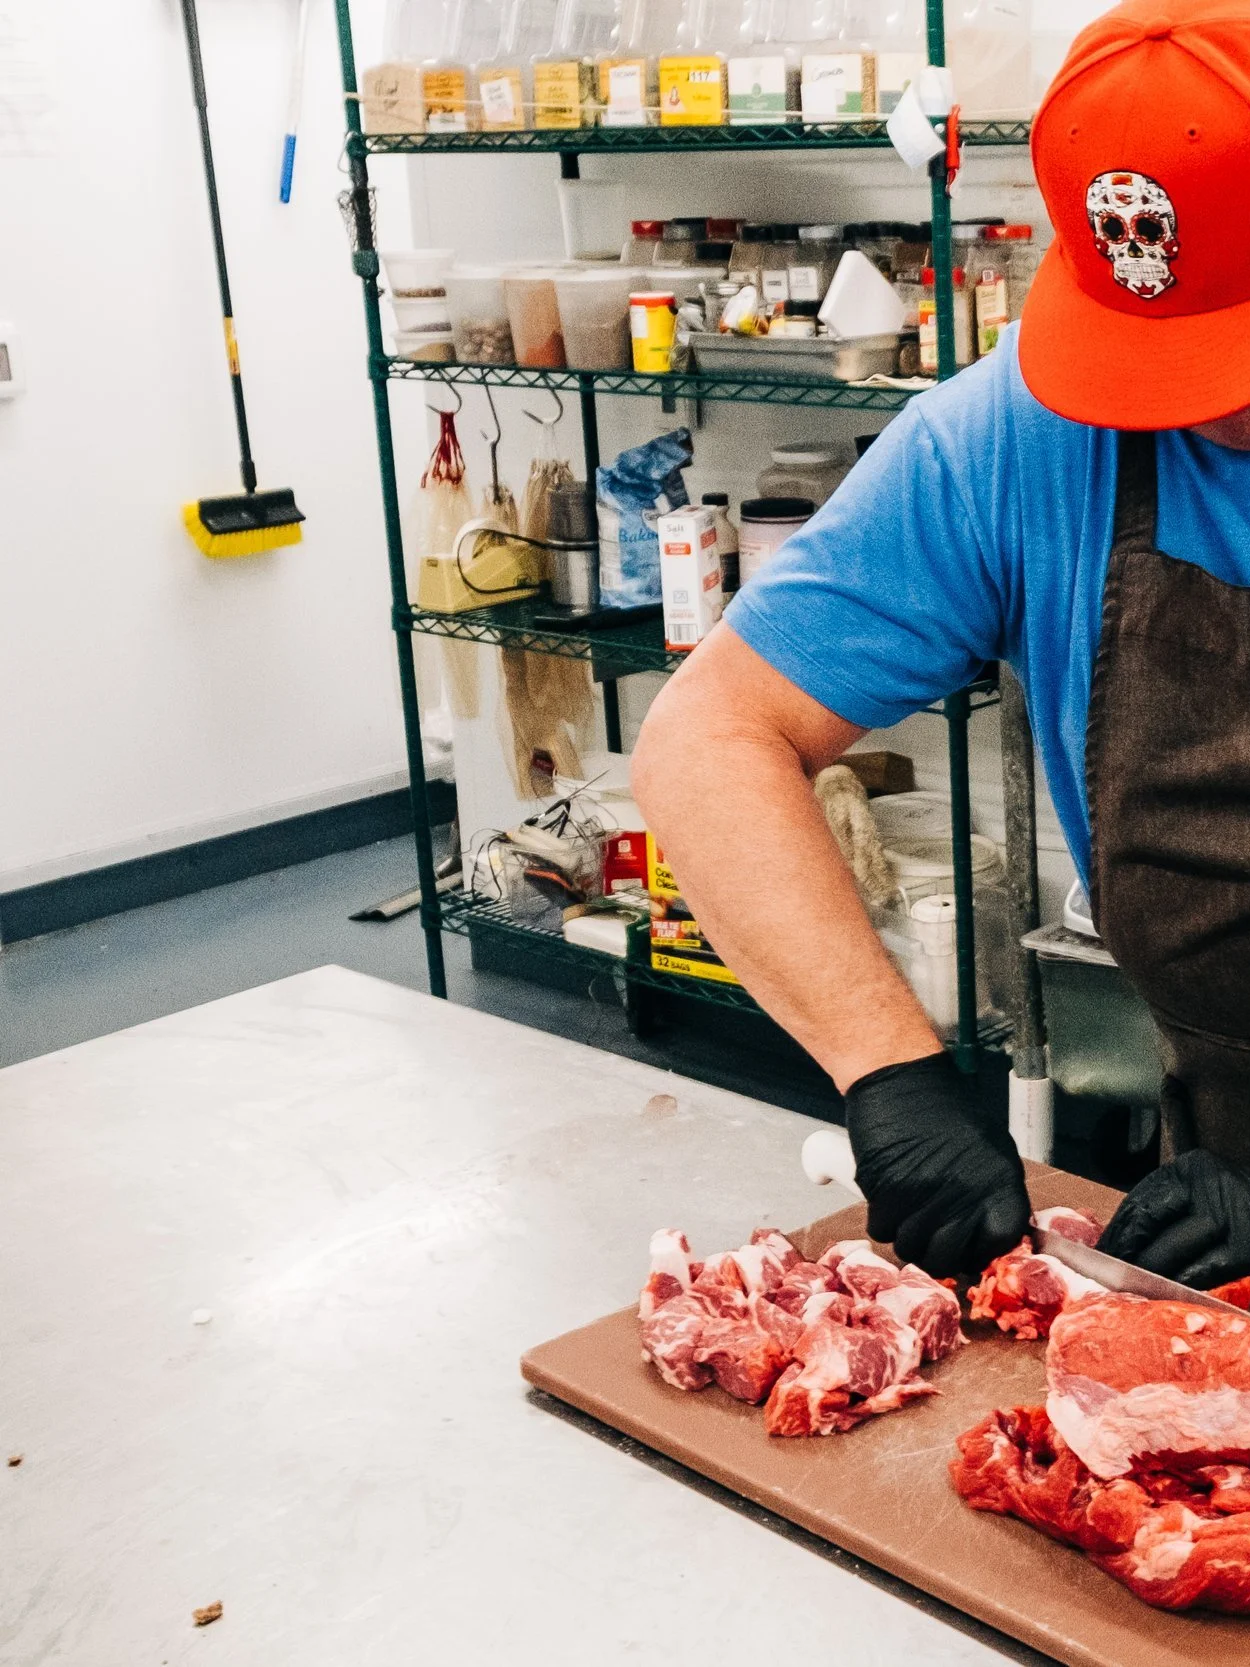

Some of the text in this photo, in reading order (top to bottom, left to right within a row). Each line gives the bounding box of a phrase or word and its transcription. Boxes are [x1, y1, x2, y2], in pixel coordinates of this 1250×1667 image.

[666, 524, 684, 533] Salt
[656, 955, 691, 972] 32 BAGS
